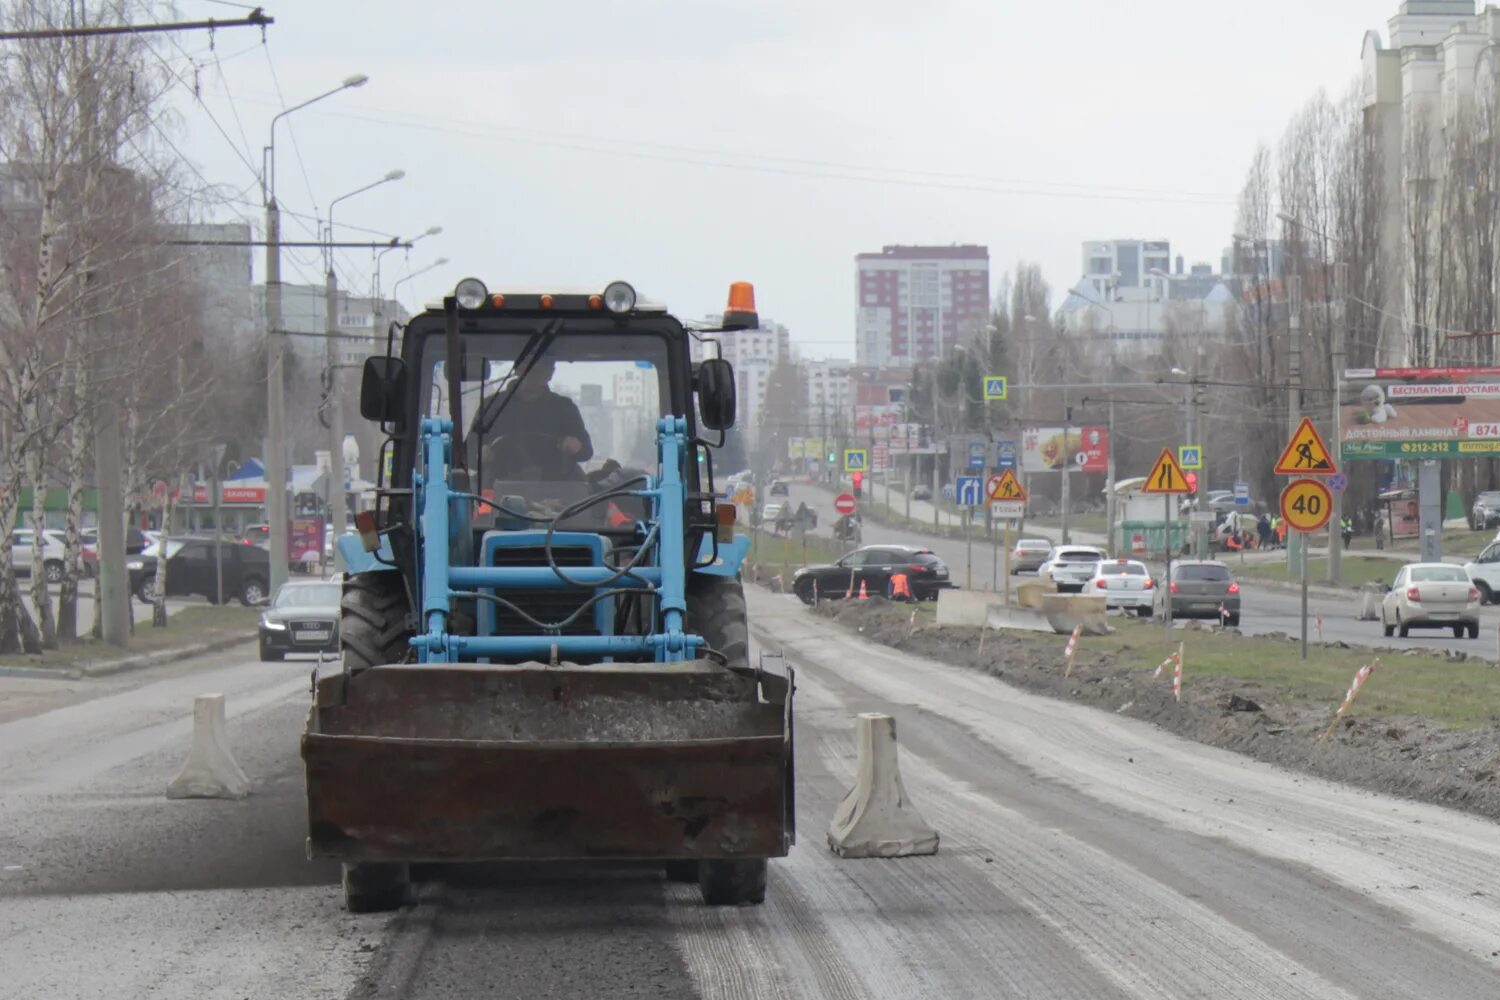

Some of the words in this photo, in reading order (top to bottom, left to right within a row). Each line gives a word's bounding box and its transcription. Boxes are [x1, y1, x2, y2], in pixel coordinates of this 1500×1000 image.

[1392, 386, 1454, 395] БЕСПЛАТНАЯ
[1475, 425, 1499, 436] 874
[1411, 442, 1449, 452] 212-212
[1292, 494, 1321, 515] 40
